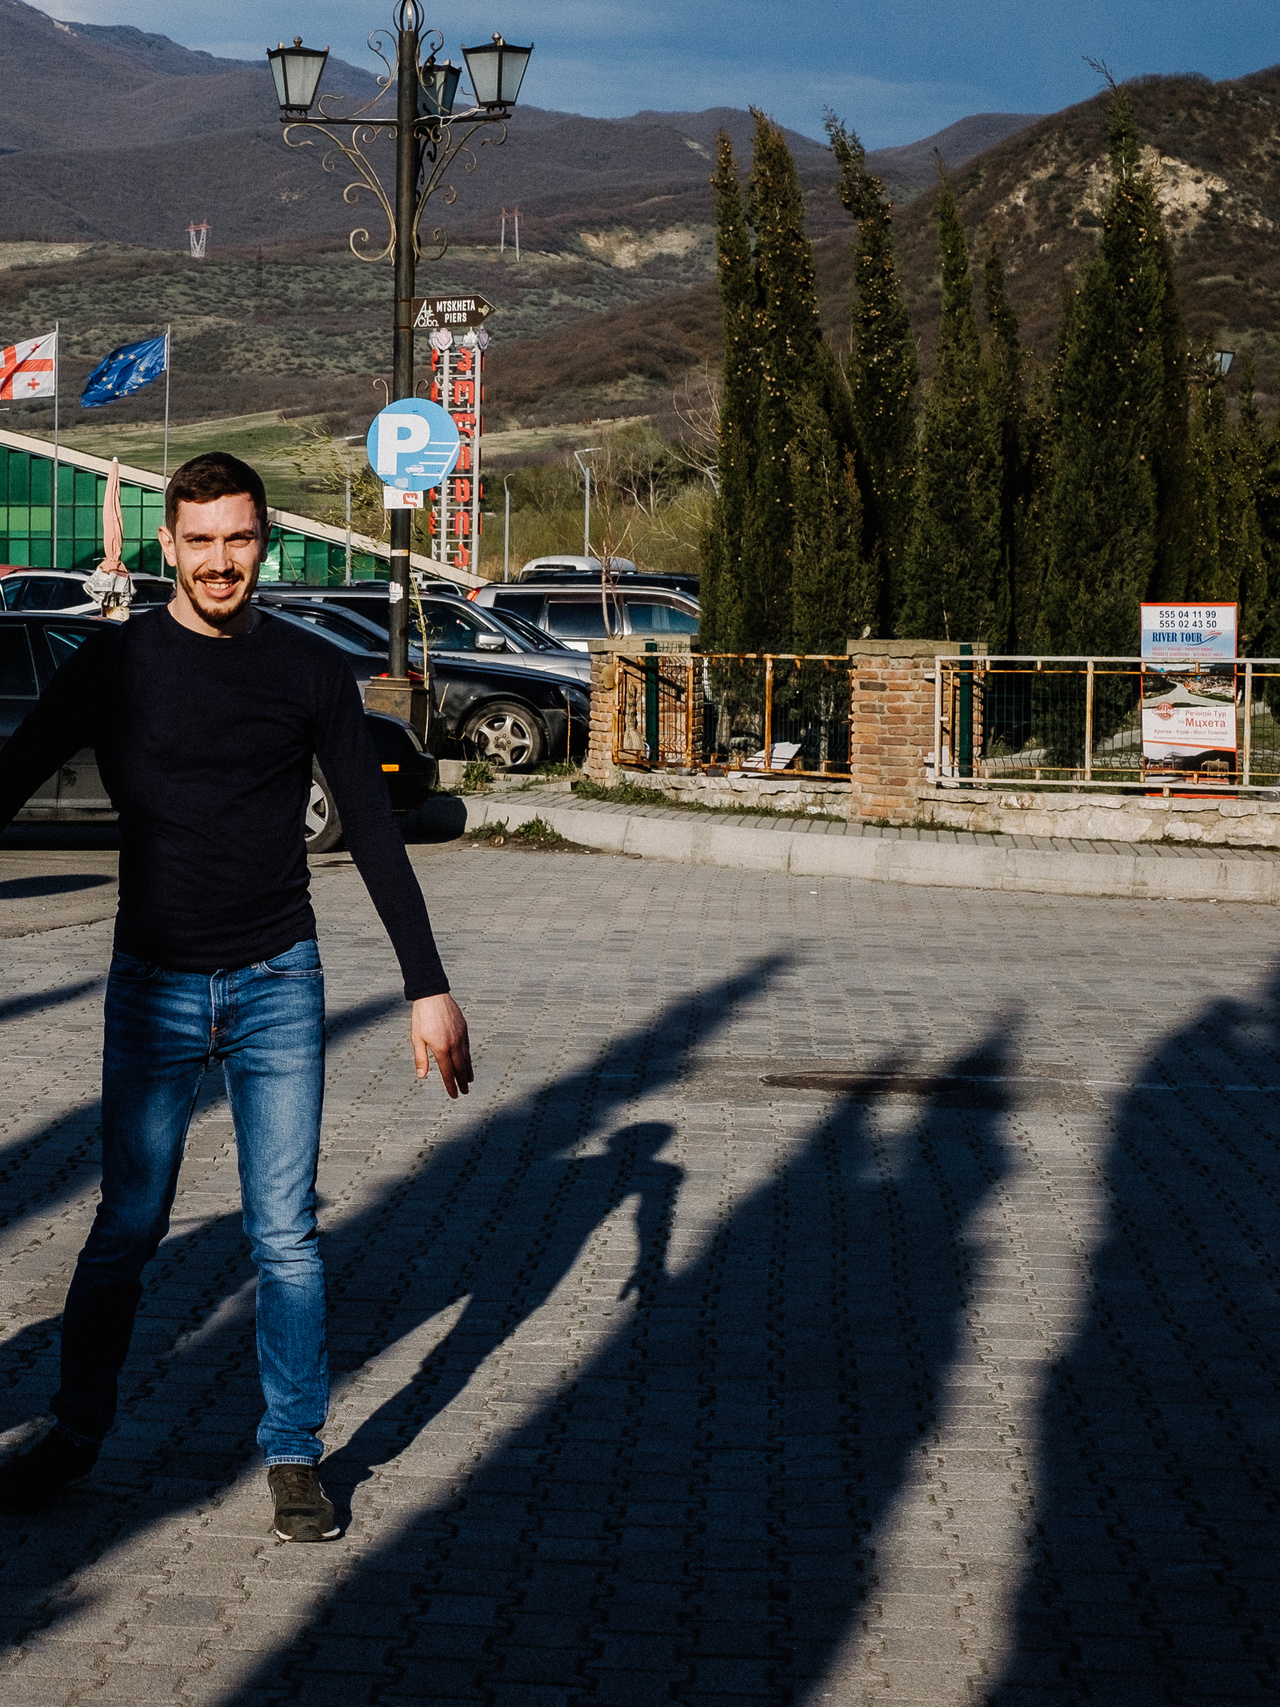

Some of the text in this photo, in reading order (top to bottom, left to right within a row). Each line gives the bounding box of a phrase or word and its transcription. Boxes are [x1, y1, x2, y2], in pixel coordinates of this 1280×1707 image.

[436, 300, 475, 312] MTSKHETA
[444, 313, 467, 323] PIERS
[377, 413, 430, 475] P
[1159, 610, 1217, 619] 555 04 11 99
[1159, 620, 1217, 629] 555 02 43 50
[1152, 632, 1202, 643] RIVER TOUR
[1214, 710, 1227, 718] Тур
[1185, 717, 1226, 728] Мцхета
